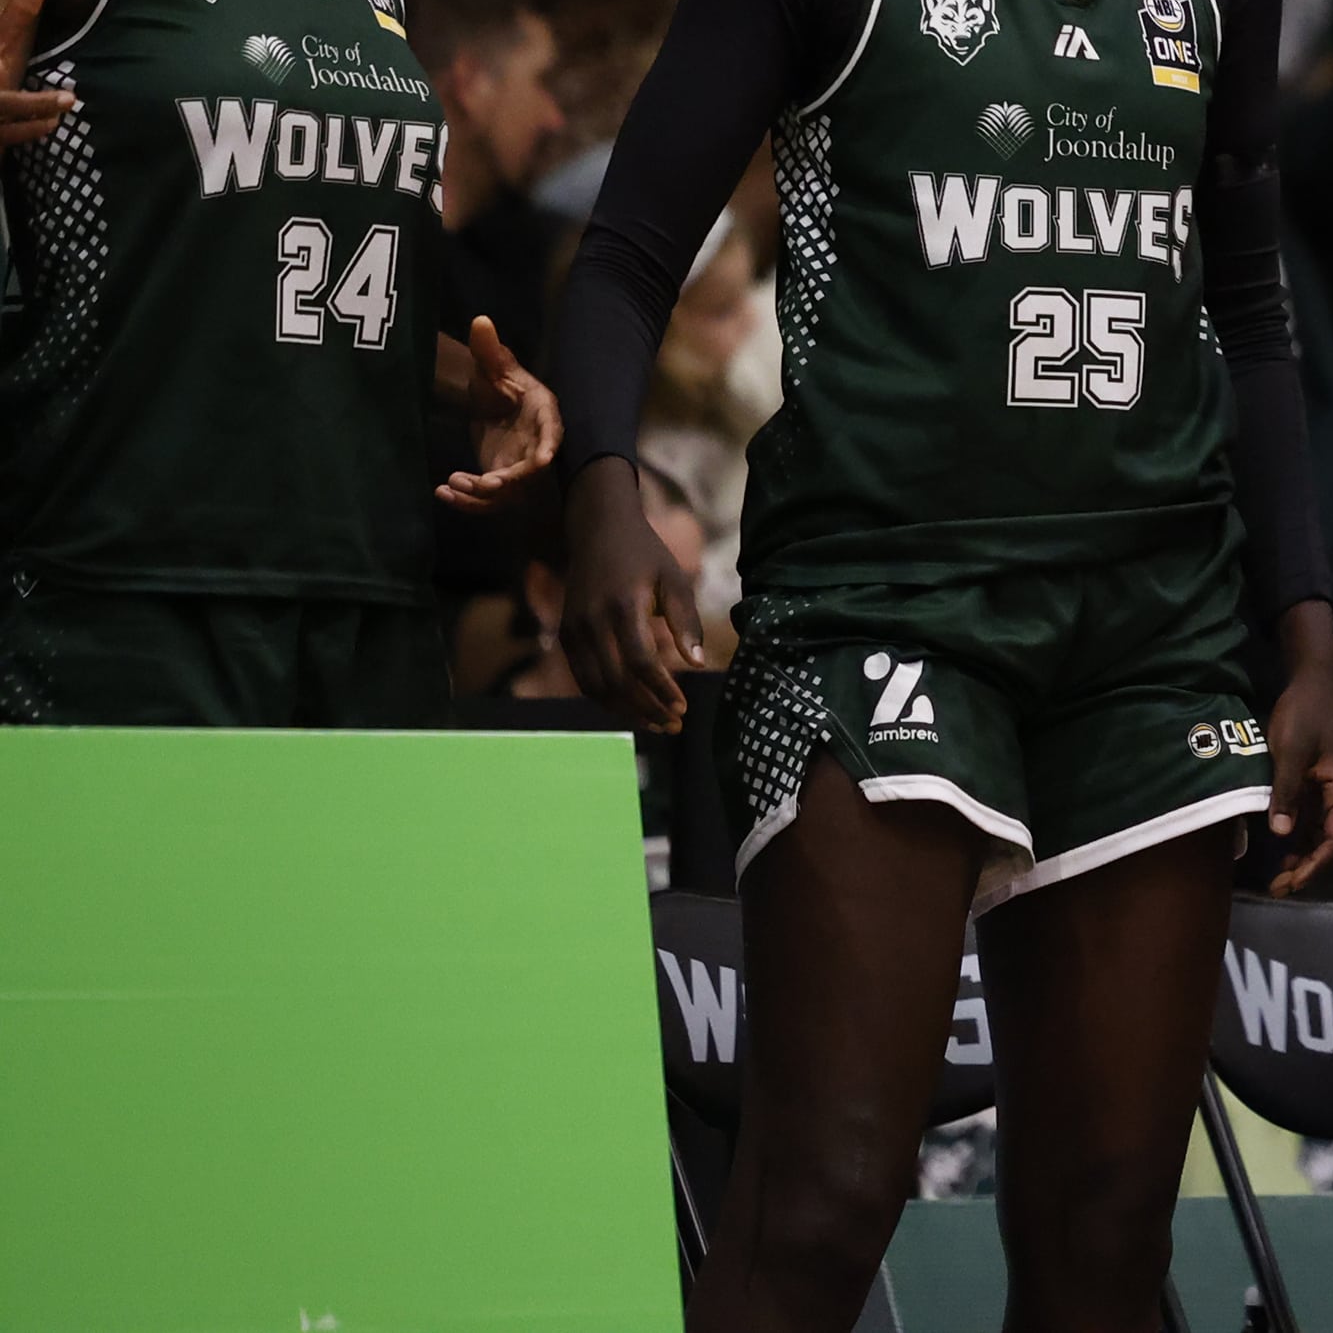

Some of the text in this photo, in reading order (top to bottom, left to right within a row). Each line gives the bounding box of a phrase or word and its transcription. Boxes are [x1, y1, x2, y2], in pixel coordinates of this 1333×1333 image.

[1153, 0, 1177, 18] NBL
[301, 34, 361, 66] City of
[1153, 36, 1197, 65] ONE
[304, 58, 430, 102] Joondalup
[1046, 102, 1117, 134] City of
[1044, 128, 1176, 171] Joondalup
[908, 170, 1193, 284] WOLVES
[275, 216, 400, 350] 24
[1006, 286, 1147, 411] 25
